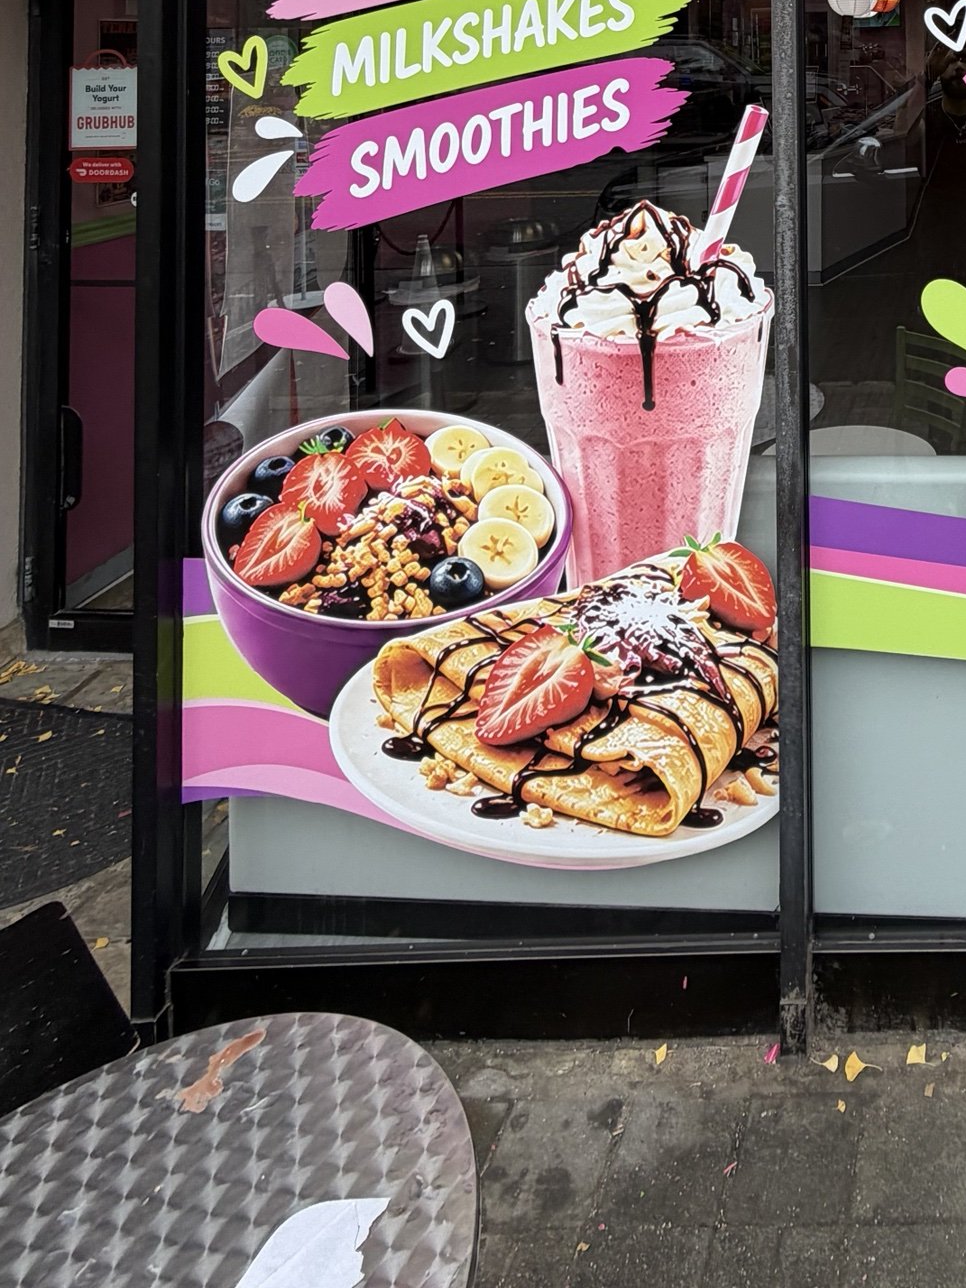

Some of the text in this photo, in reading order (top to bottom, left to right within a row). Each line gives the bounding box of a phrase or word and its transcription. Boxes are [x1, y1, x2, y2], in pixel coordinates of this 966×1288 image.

[85, 85, 106, 93] Build
[92, 95, 120, 103] Yogurt
[77, 115, 135, 130] GRUBHUB
[350, 78, 630, 198] SMOOTHIES
